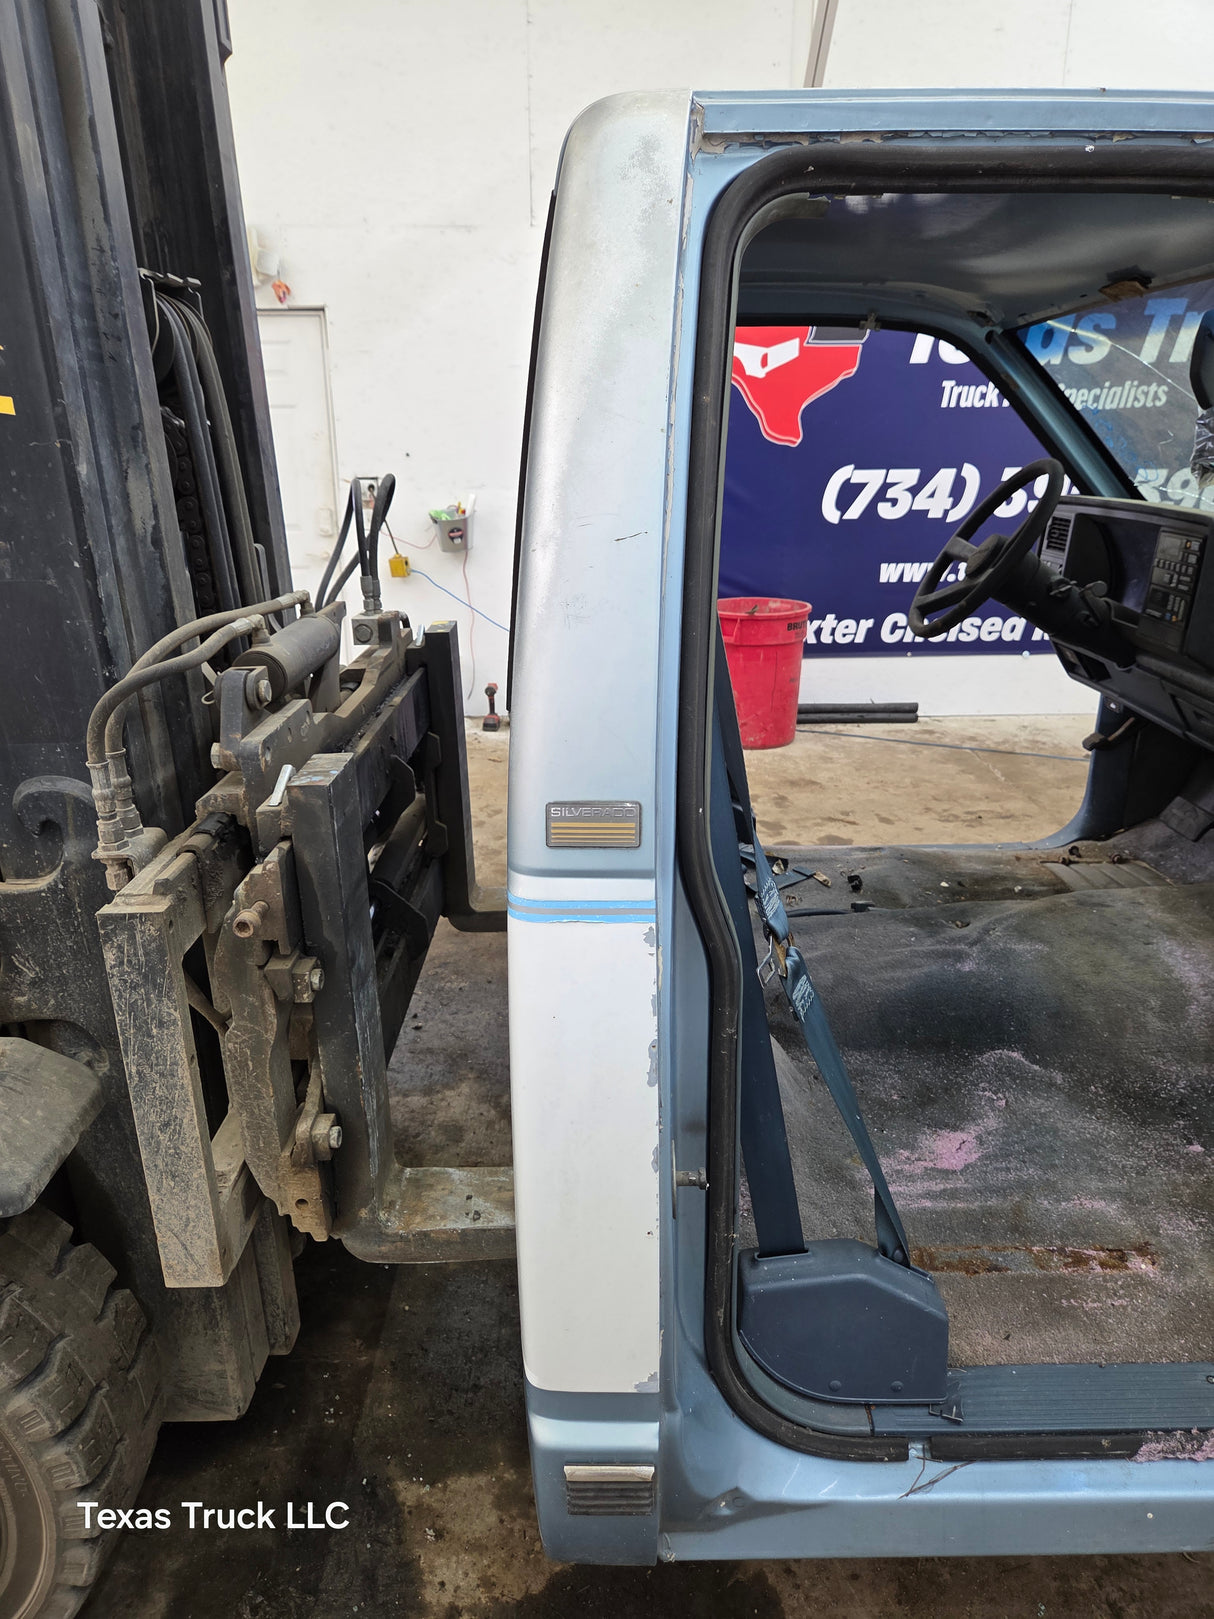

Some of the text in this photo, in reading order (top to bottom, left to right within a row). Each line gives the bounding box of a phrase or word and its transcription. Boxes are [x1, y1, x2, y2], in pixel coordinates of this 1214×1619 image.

[1137, 297, 1203, 364] Tr
[940, 379, 1169, 411] Truck pecialists
[821, 462, 981, 525] (734)
[803, 613, 875, 644] xter
[550, 807, 636, 817] SILVERADO
